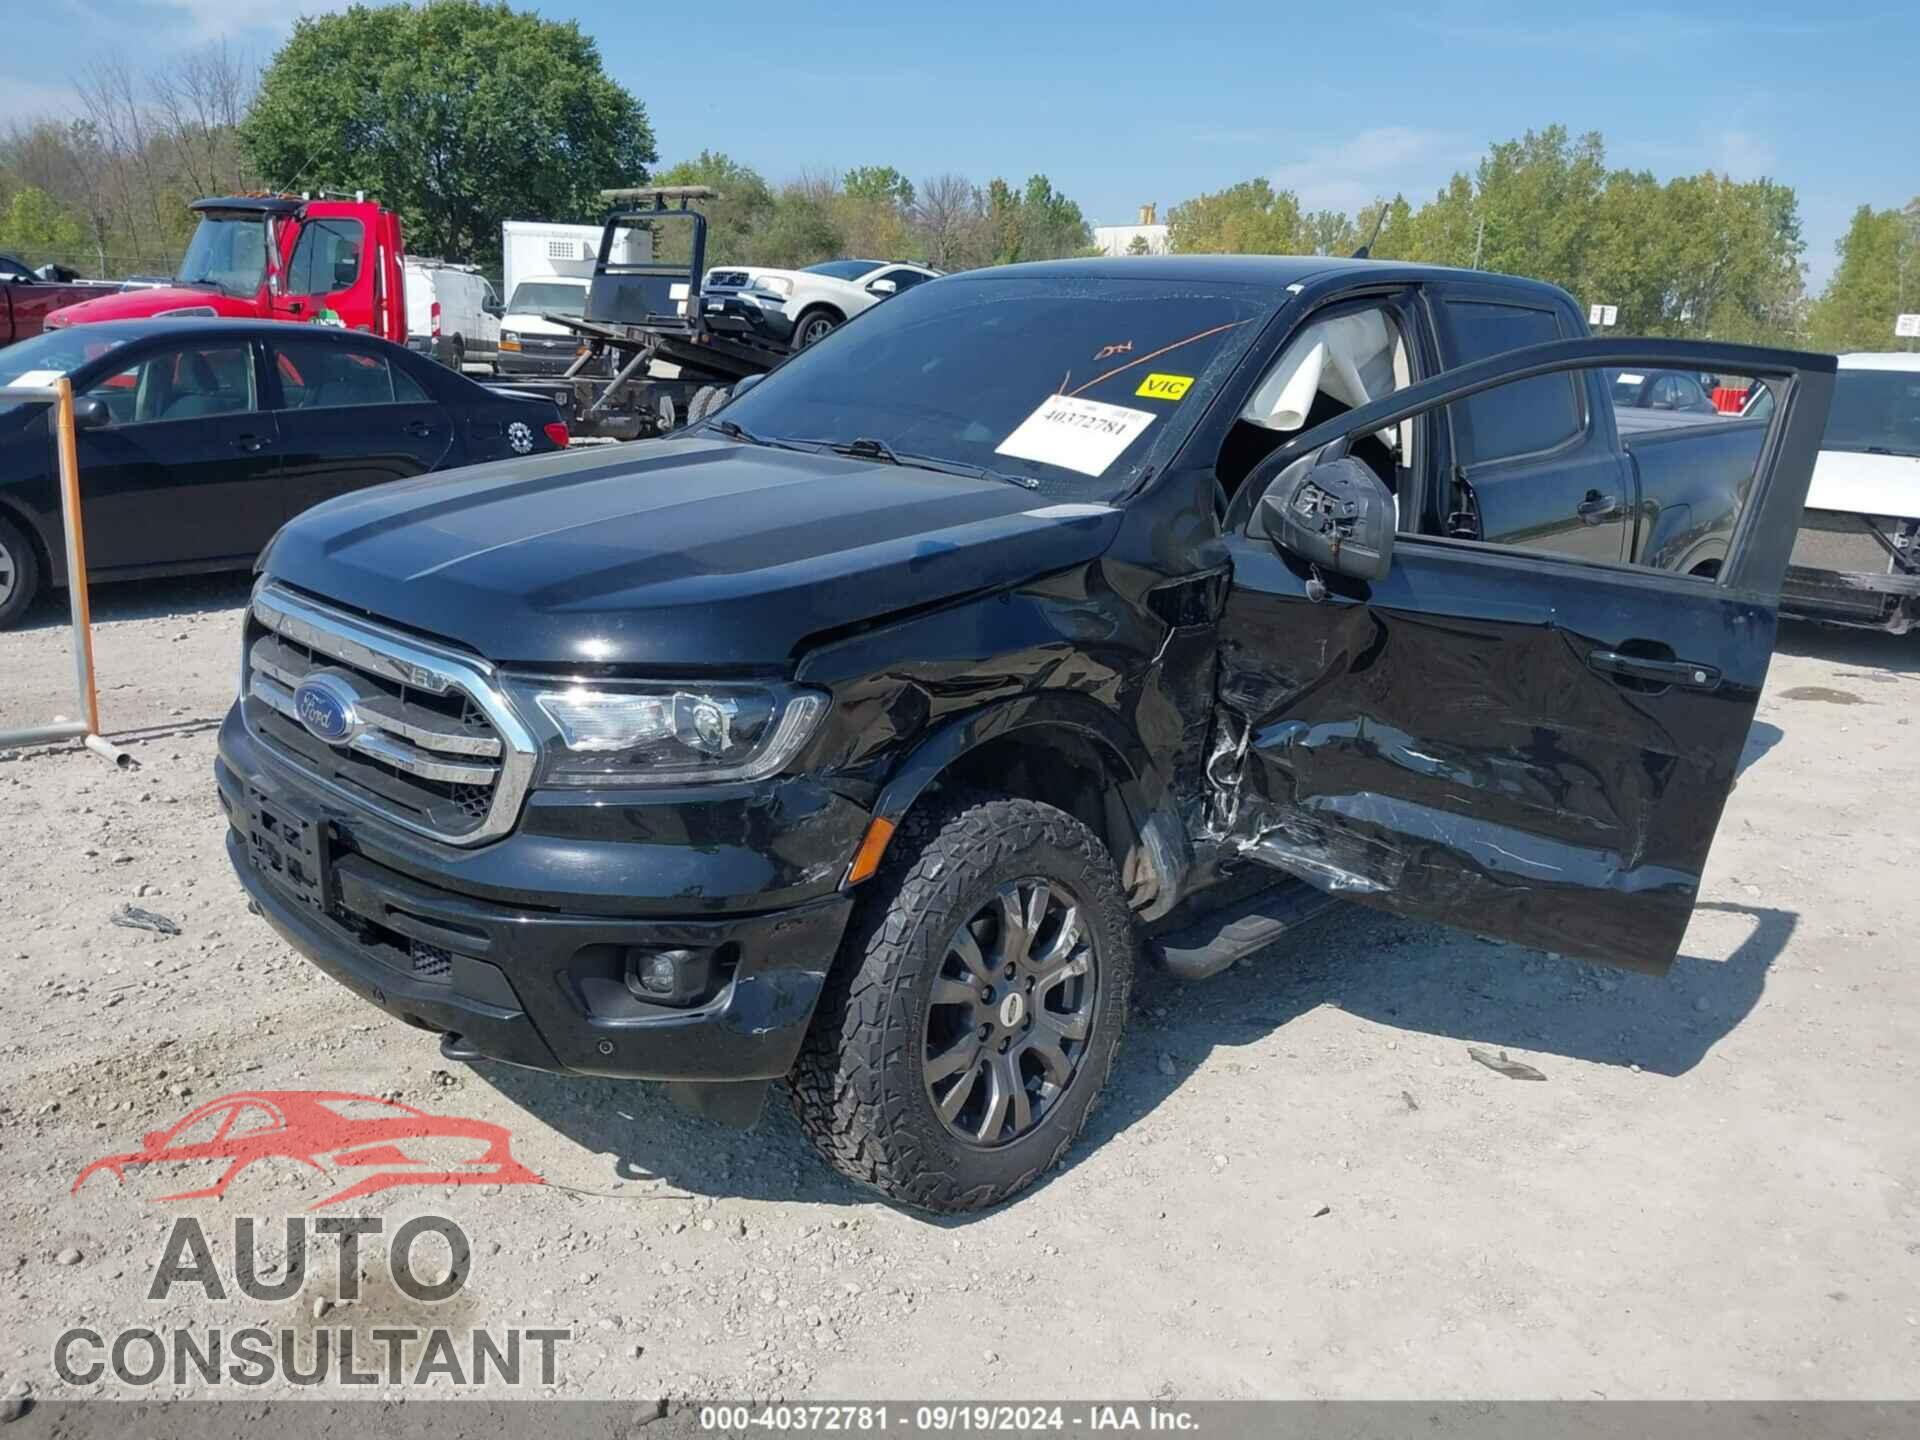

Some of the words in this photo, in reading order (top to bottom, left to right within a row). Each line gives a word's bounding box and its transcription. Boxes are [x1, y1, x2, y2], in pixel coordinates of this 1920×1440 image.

[1148, 379, 1184, 394] VIC
[1044, 410, 1127, 435] 40372781
[300, 691, 333, 729] Ford
